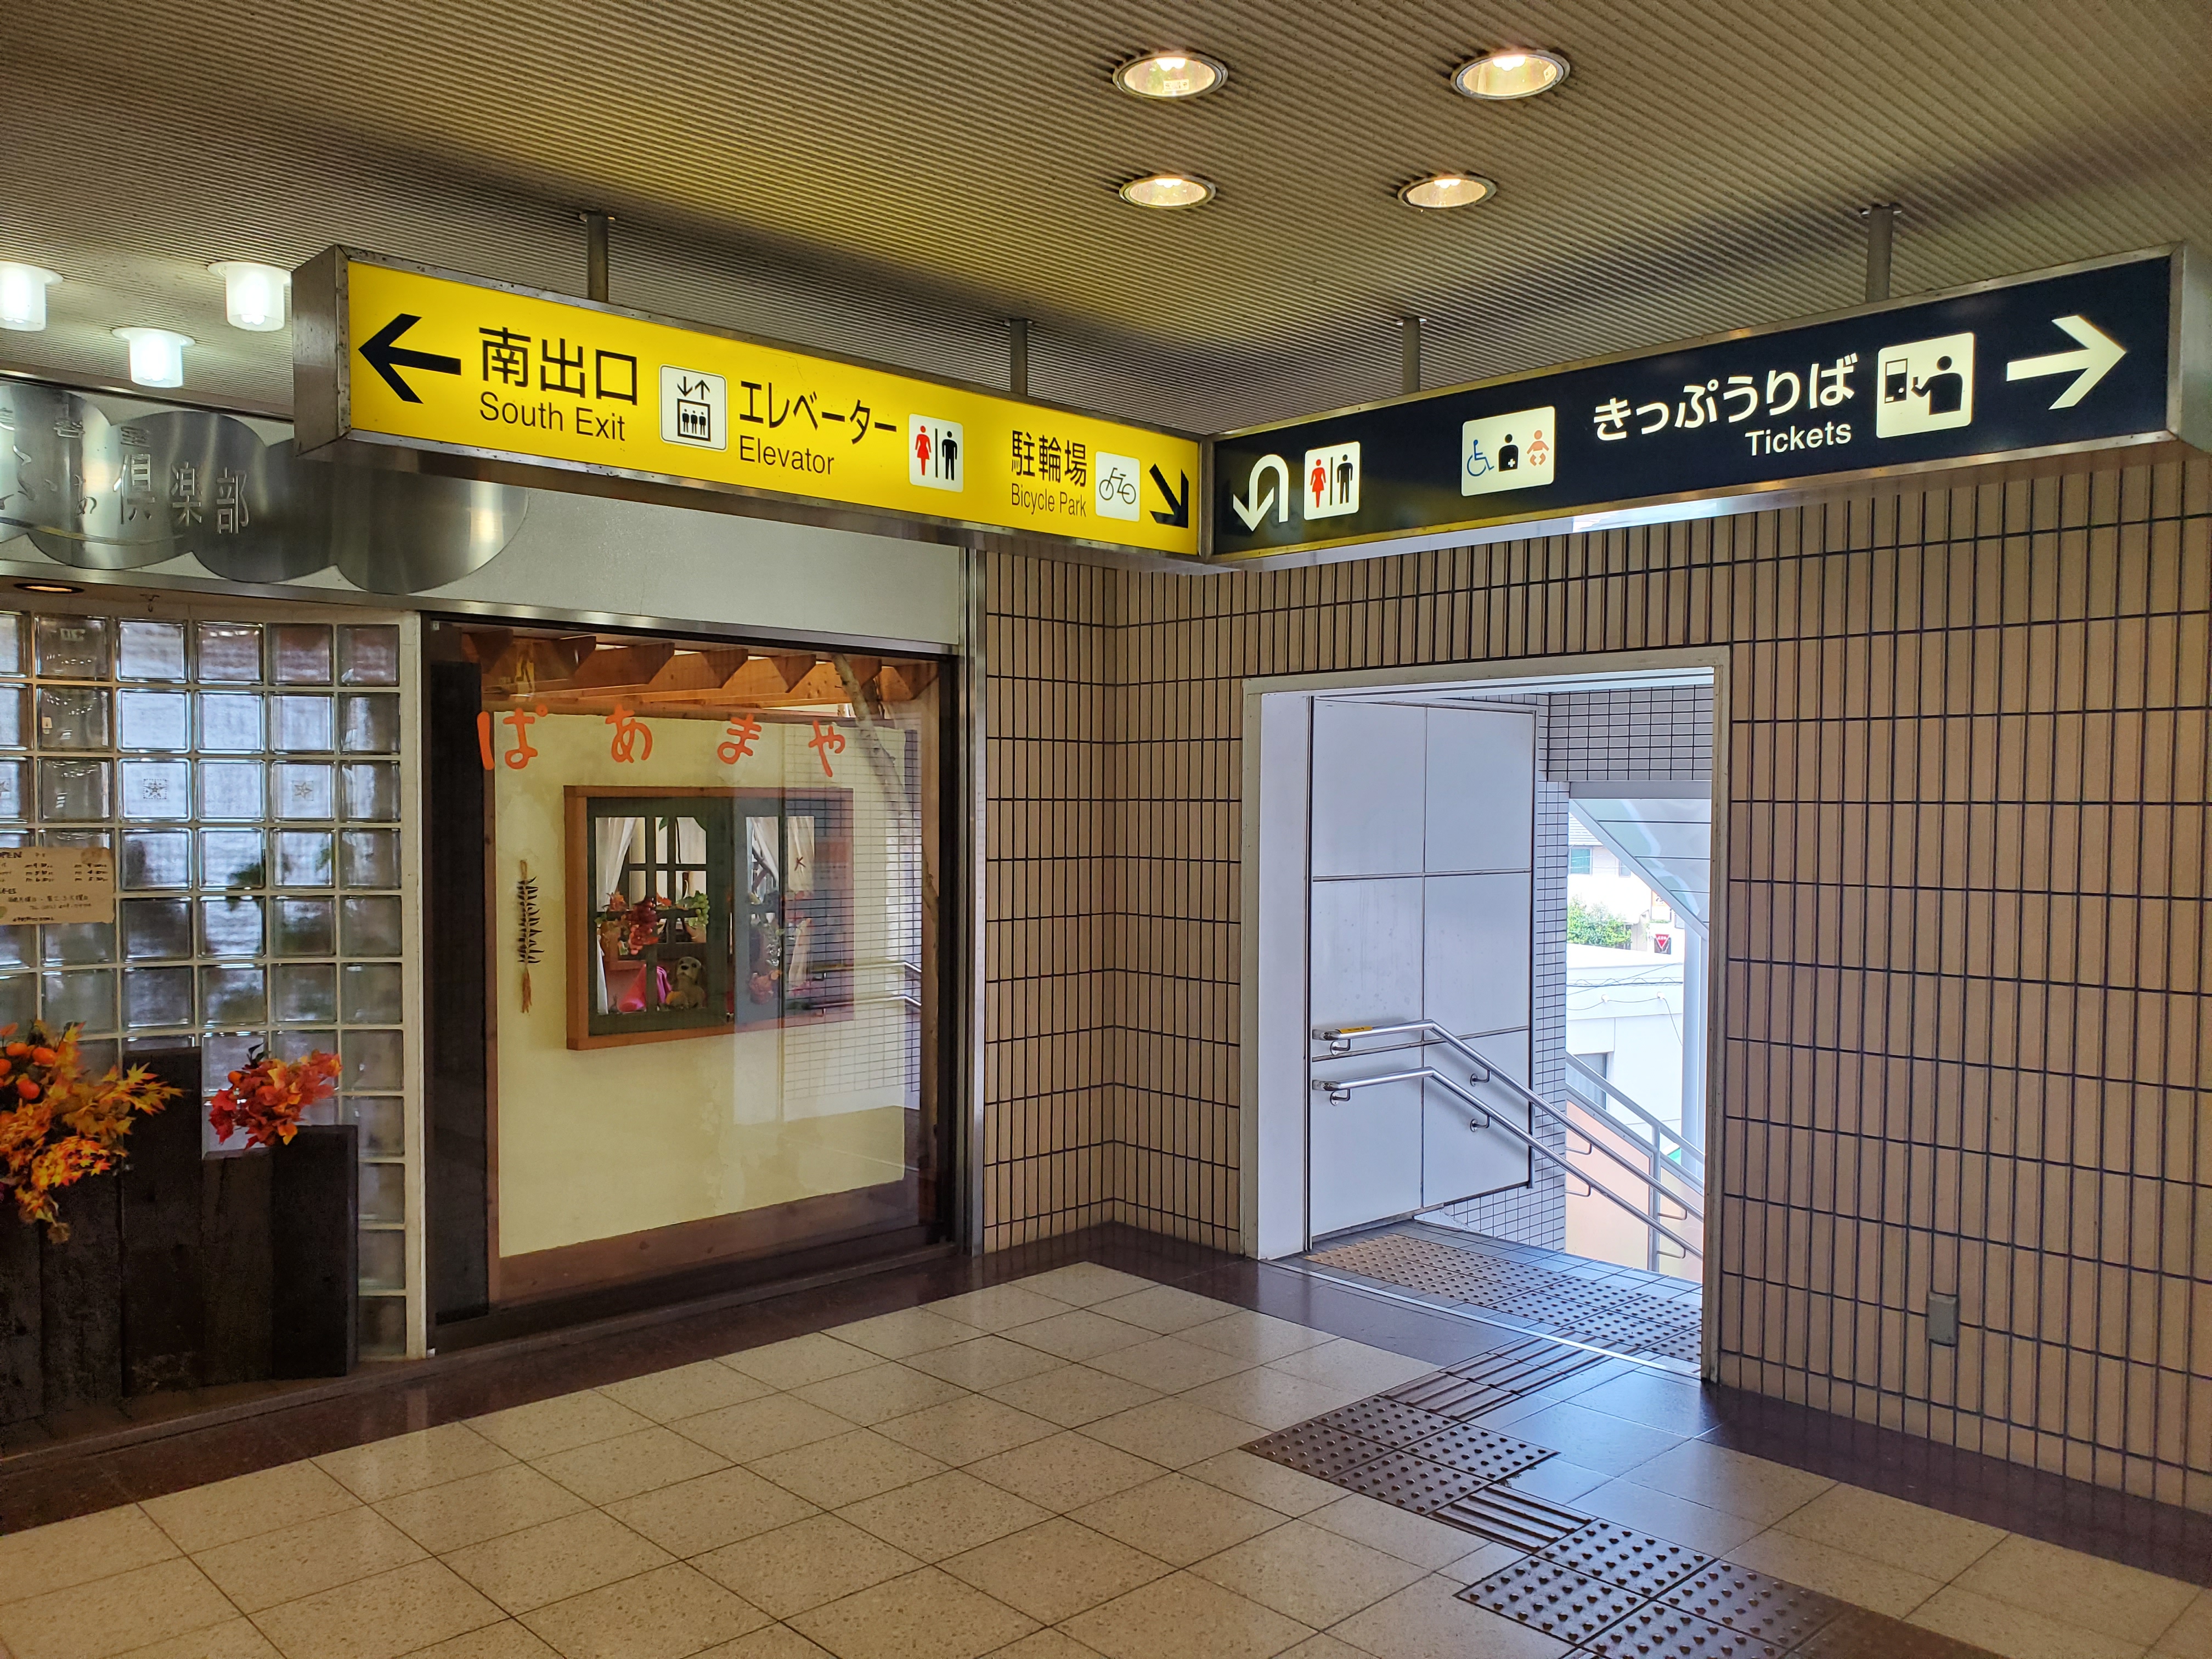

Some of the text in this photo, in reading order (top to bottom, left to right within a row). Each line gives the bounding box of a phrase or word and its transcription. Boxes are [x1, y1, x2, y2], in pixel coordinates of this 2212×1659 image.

[479, 326, 637, 406] 南出口
[479, 391, 625, 442] South Exit
[740, 380, 897, 445] エレベーター
[1593, 352, 1858, 441] きっぷうりば
[740, 435, 834, 475] Elevator
[1012, 430, 1087, 487] 駐輪場
[1745, 421, 1852, 456] Tickets
[1012, 483, 1087, 517] Bicycle Park
